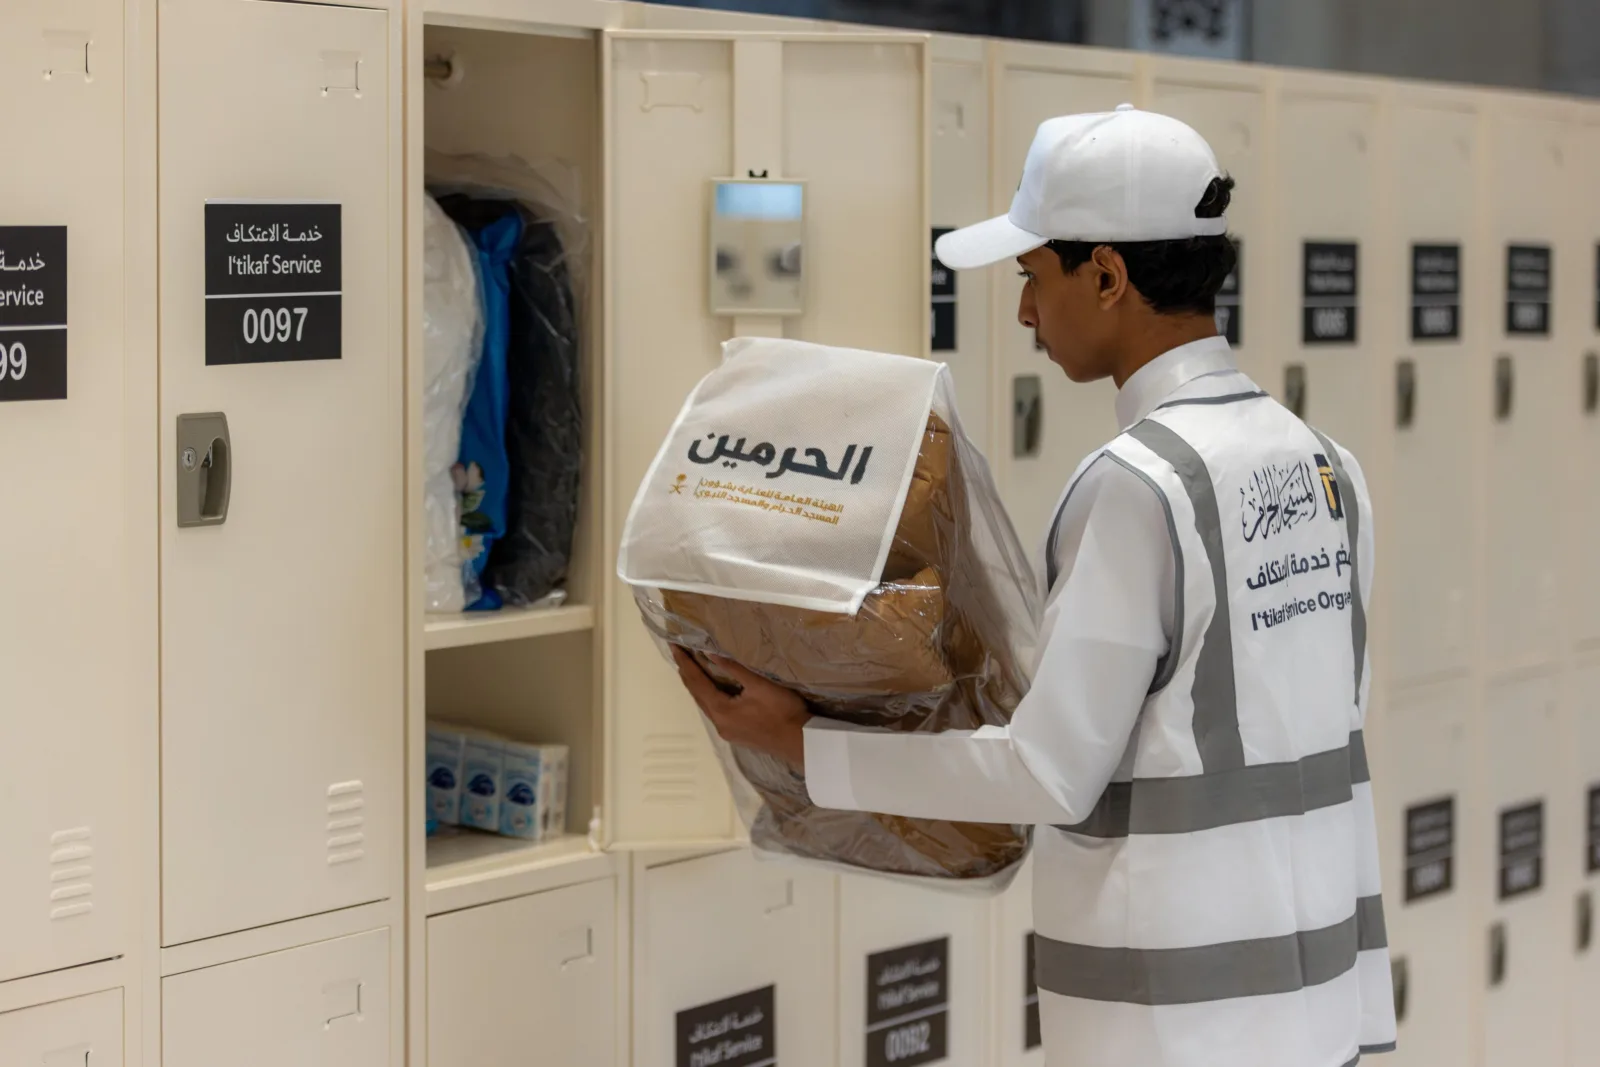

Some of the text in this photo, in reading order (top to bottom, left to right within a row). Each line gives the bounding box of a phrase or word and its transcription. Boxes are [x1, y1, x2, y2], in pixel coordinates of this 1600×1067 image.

[225, 222, 323, 244] خدمة الاعتكاف
[271, 253, 322, 275] Service
[0, 283, 44, 307] ervice
[242, 307, 309, 344] 0097
[687, 432, 874, 485] الحرمين
[726, 495, 770, 511] والمسجد
[774, 491, 813, 506] العامة
[811, 499, 844, 514] الهيئة
[768, 503, 803, 517] الحرام
[801, 510, 840, 526] المسجد
[1290, 546, 1331, 576] خدمة
